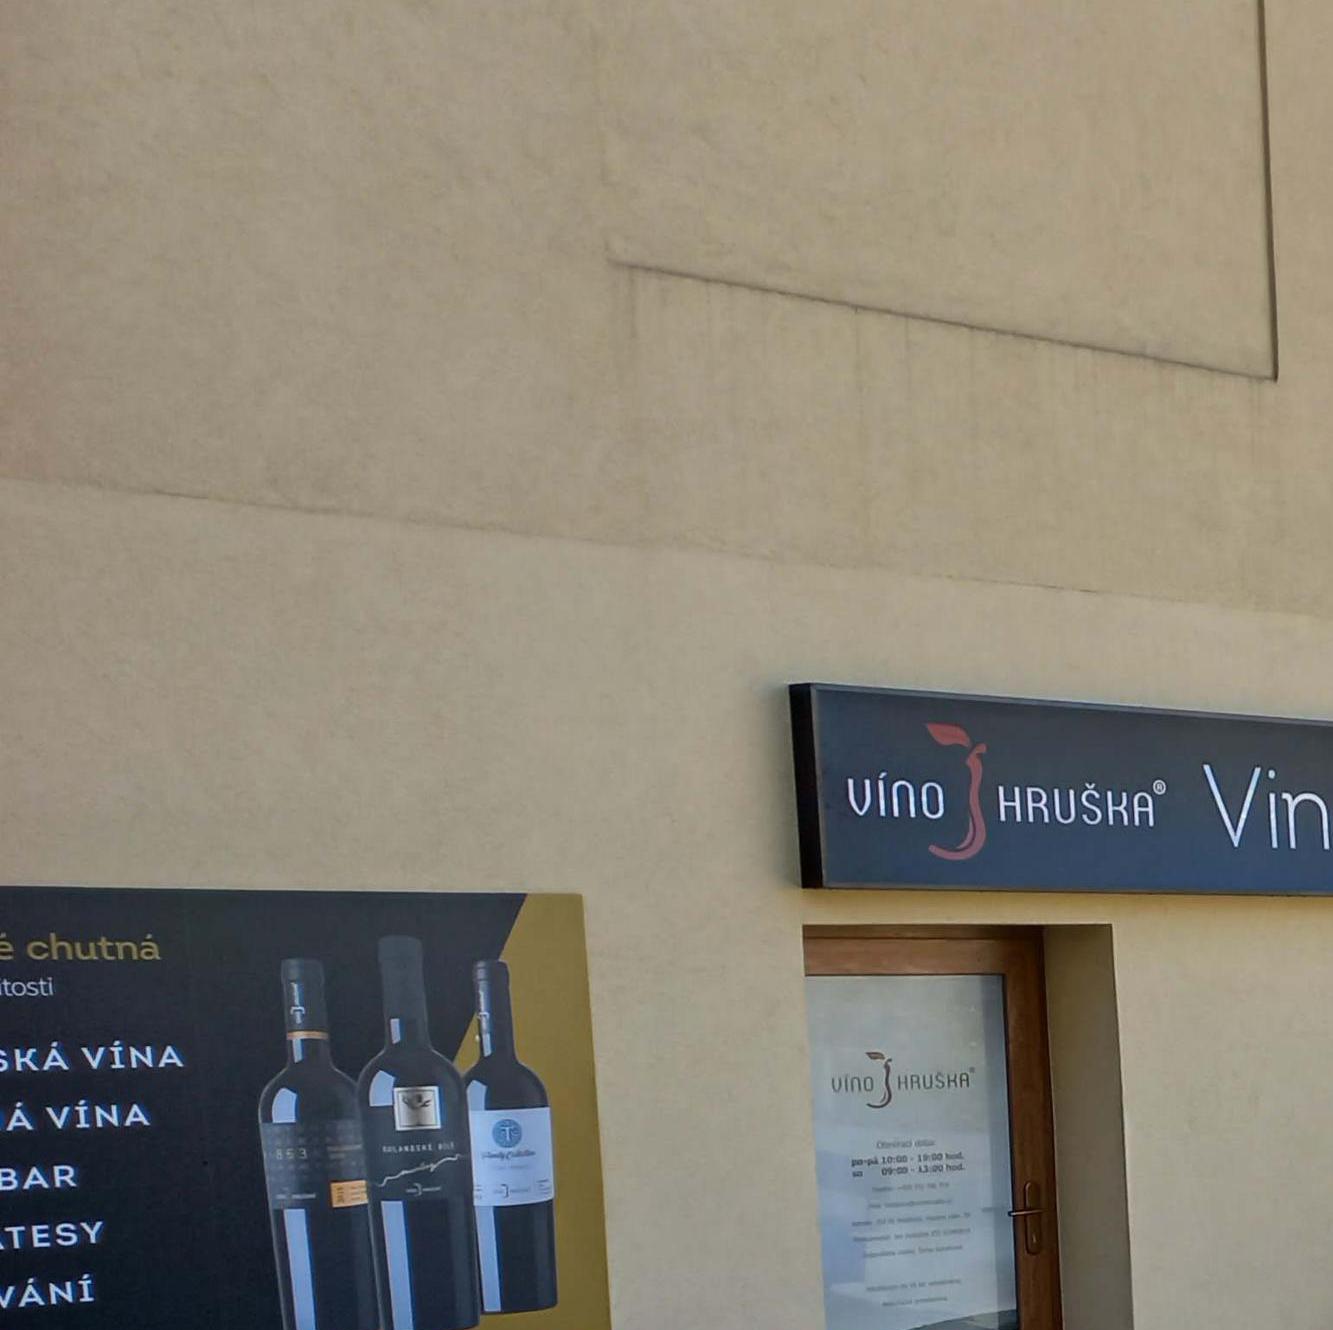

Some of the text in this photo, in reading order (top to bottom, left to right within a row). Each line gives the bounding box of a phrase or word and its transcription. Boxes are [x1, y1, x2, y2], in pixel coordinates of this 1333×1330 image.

[27, 932, 161, 961] chutná
[0, 977, 54, 997] tosti
[81, 1040, 184, 1069] VÍNA
[46, 1099, 150, 1129] VÍNA
[0, 1165, 77, 1191] BAR
[0, 1221, 103, 1250] TESY
